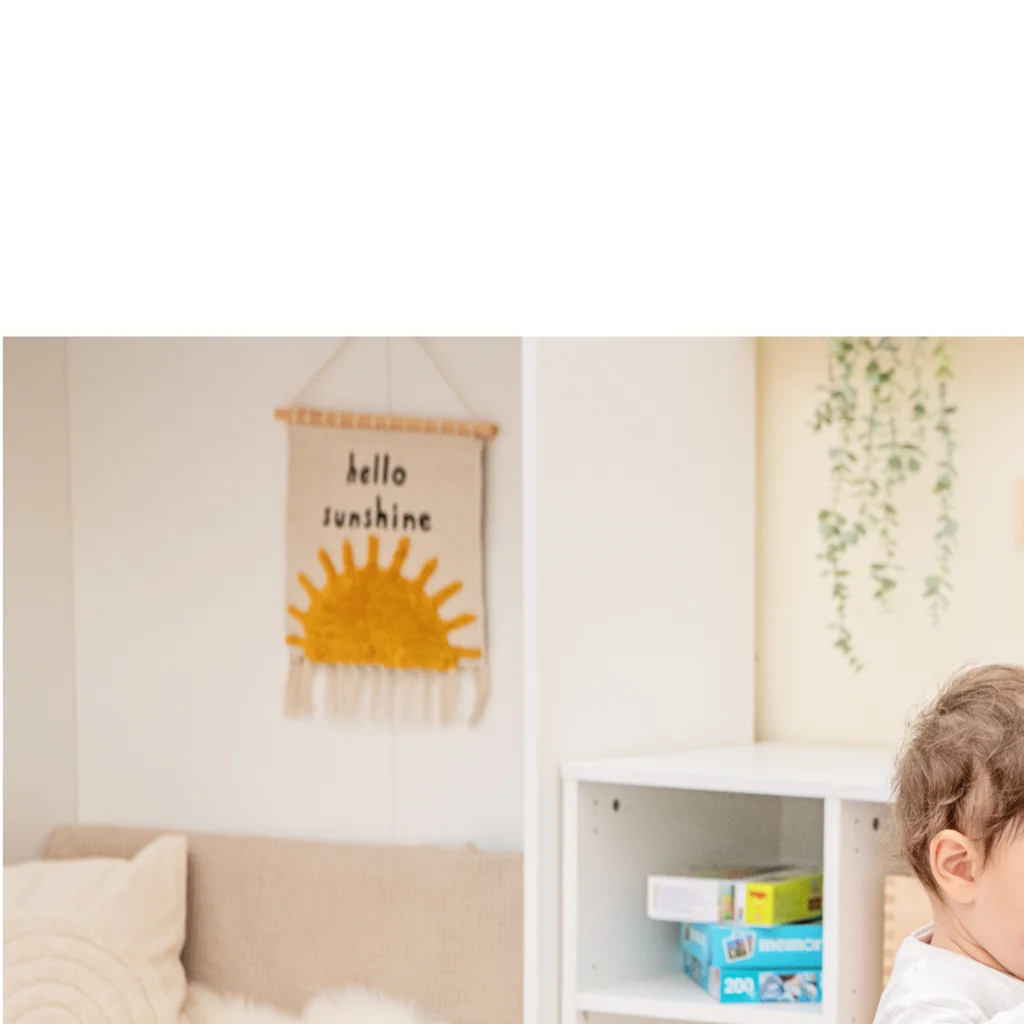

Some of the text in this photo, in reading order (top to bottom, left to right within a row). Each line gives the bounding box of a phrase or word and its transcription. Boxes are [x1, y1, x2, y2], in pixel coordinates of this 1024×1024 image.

[346, 449, 407, 487] hello
[322, 495, 432, 532] sunshine
[723, 976, 755, 995] 200
